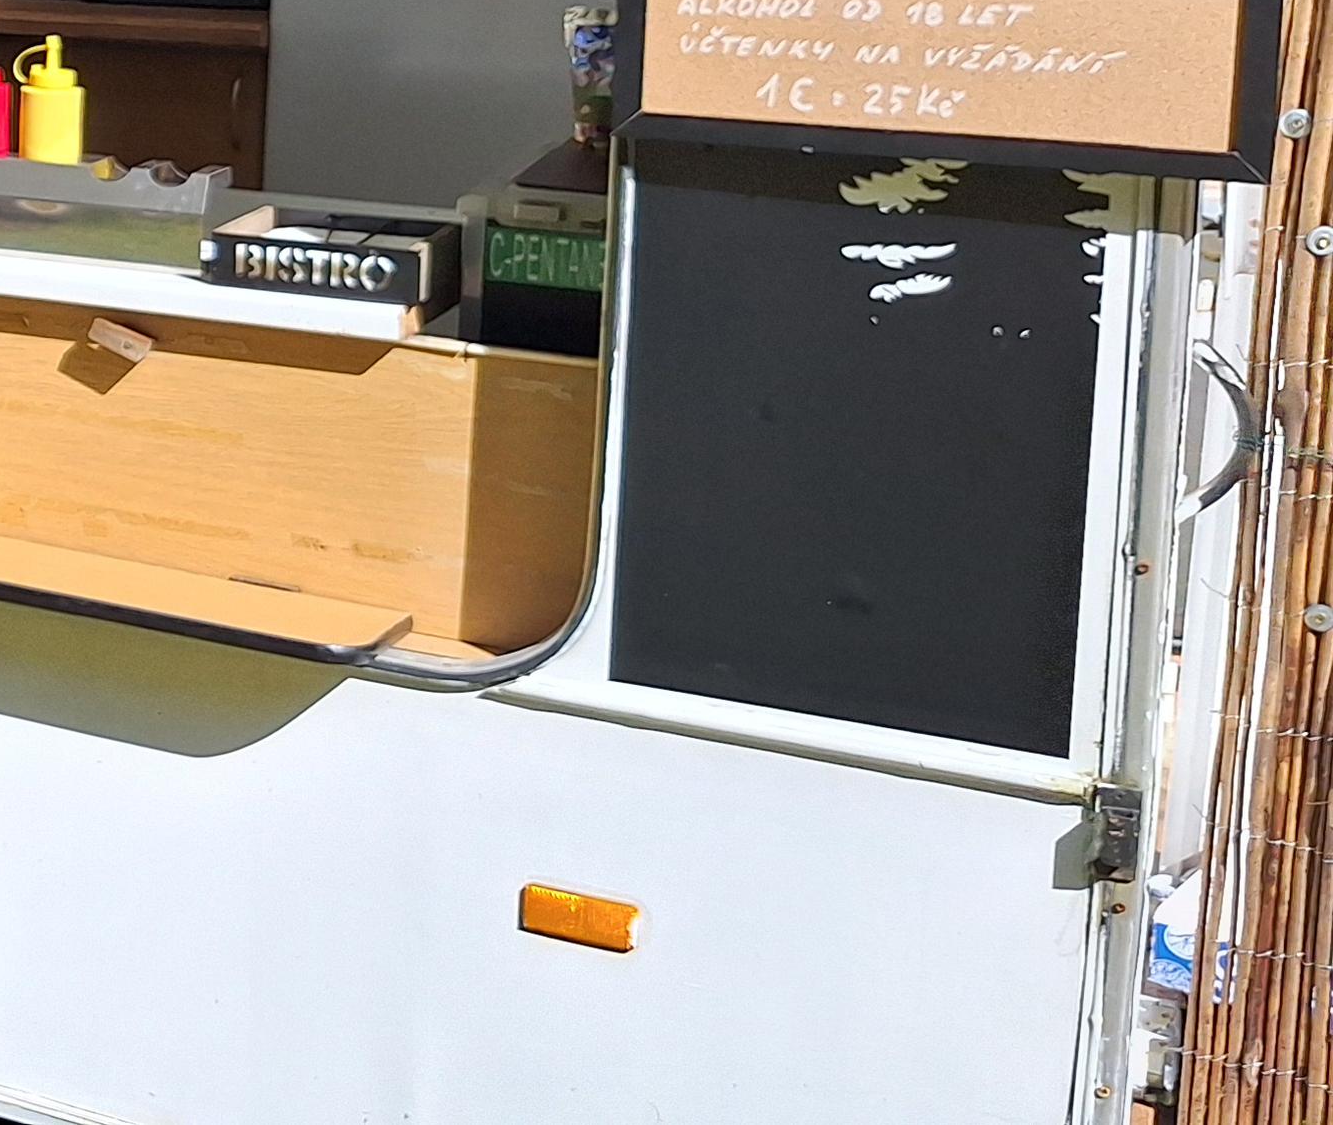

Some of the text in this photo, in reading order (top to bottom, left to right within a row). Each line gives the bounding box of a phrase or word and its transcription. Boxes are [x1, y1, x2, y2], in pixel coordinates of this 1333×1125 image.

[906, 0, 945, 27] 18
[958, 3, 1035, 27] LET
[679, 21, 1128, 75] ÚČTENKY NA VYŽÁDÁNÍ
[234, 242, 398, 293] BISTRO
